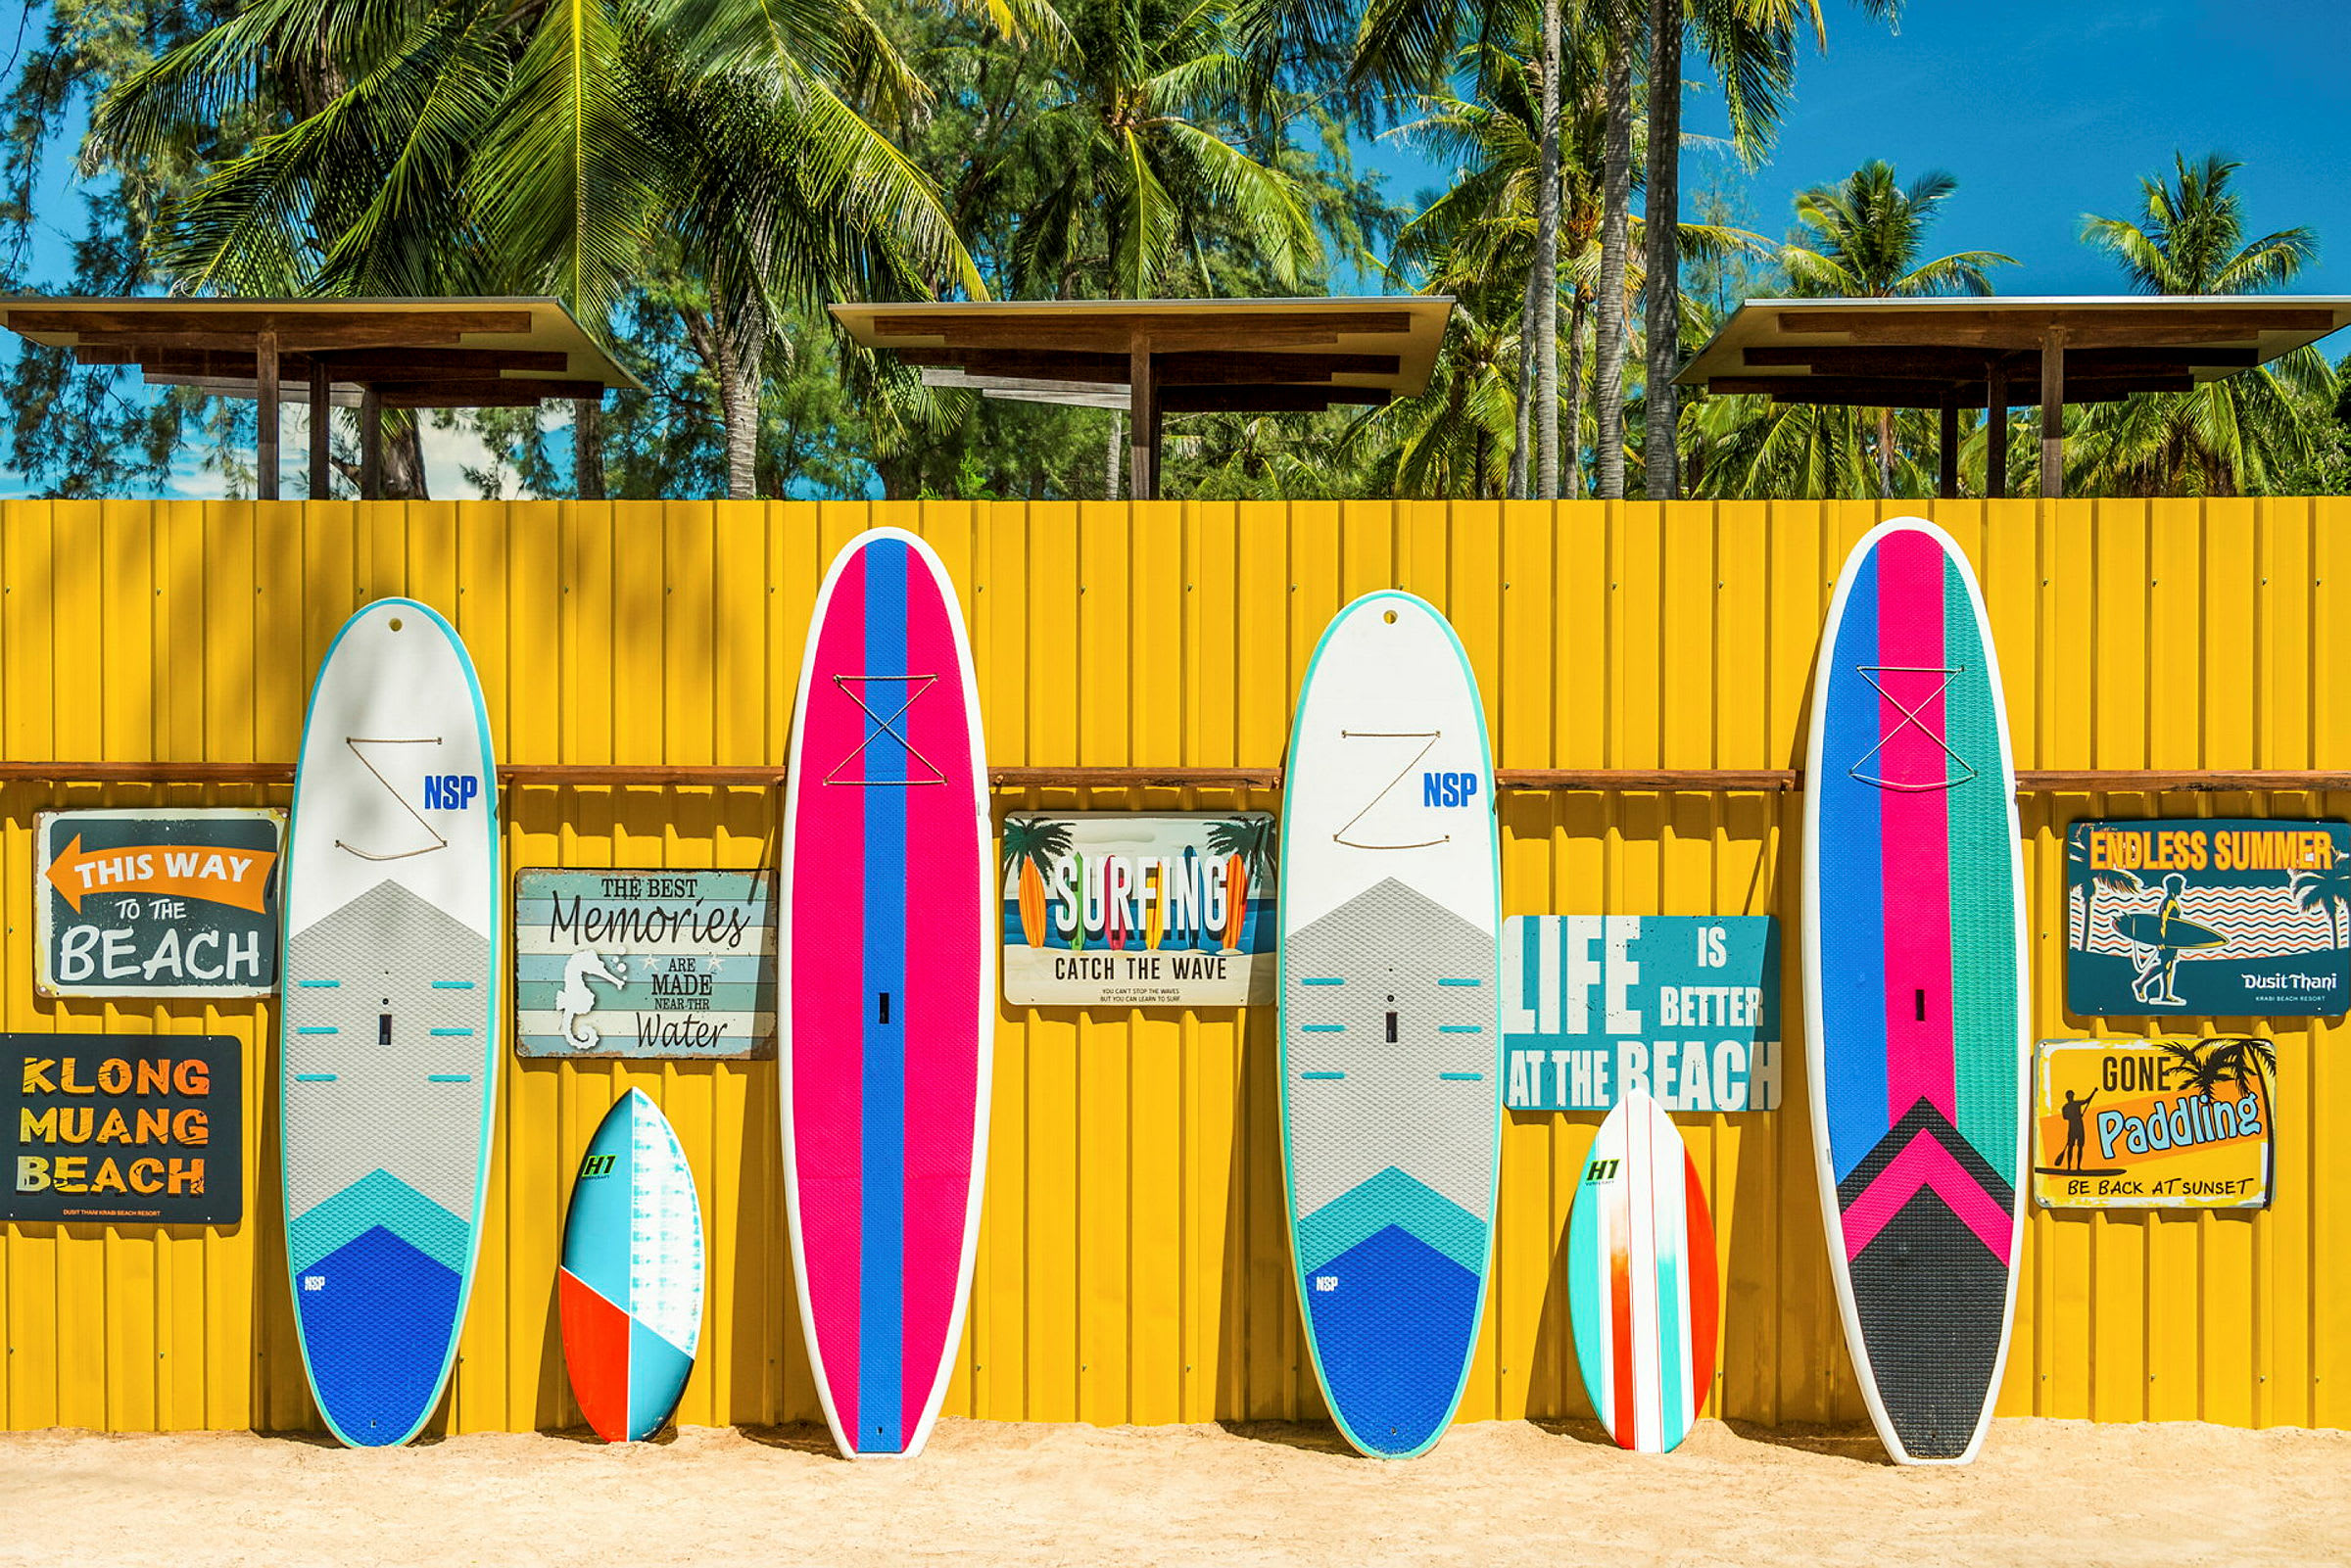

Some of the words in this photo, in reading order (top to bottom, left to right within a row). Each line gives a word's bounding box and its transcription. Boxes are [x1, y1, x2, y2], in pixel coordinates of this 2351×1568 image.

[424, 775, 478, 810] NSP
[1423, 773, 1477, 808] NSP
[2089, 831, 2208, 871] ENDLESS
[2214, 831, 2332, 871] SUMMER
[74, 854, 154, 888] THIS
[165, 853, 253, 882] WAY
[601, 879, 641, 897] THE
[648, 879, 697, 898] BEST
[1055, 855, 1228, 935] SURFING
[116, 899, 140, 919] TO
[149, 899, 187, 920] THE
[550, 889, 751, 947] Memories
[60, 925, 260, 980] BEACH
[669, 958, 696, 973] ARE
[1055, 957, 1115, 980] CATCH
[1127, 957, 1161, 980] THE
[1173, 957, 1226, 980] WAVE
[651, 974, 713, 996] MADE
[1502, 915, 1642, 1034] LIFE
[1697, 927, 1727, 968] IS
[2241, 973, 2288, 989] Dusit
[2288, 973, 2337, 992] Thani
[654, 998, 685, 1010] NEAR
[1660, 986, 1764, 1026] BETTER
[636, 1012, 729, 1048] Water
[22, 1057, 211, 1095] KLONG
[1508, 1050, 1546, 1107] AT
[1552, 1050, 1609, 1107] THE
[1617, 1040, 1782, 1112] BEACH
[2102, 1056, 2172, 1092] GONE
[20, 1107, 210, 1145] MUANG
[2097, 1091, 2263, 1159] Paddling
[16, 1155, 205, 1194] BEACH
[2068, 1180, 2090, 1195] BE
[2098, 1179, 2144, 1195] BACK
[2152, 1178, 2182, 1194] AT
[2183, 1178, 2254, 1195] SUNSET
[305, 1275, 325, 1291] NSP
[1316, 1276, 1338, 1292] NSP
